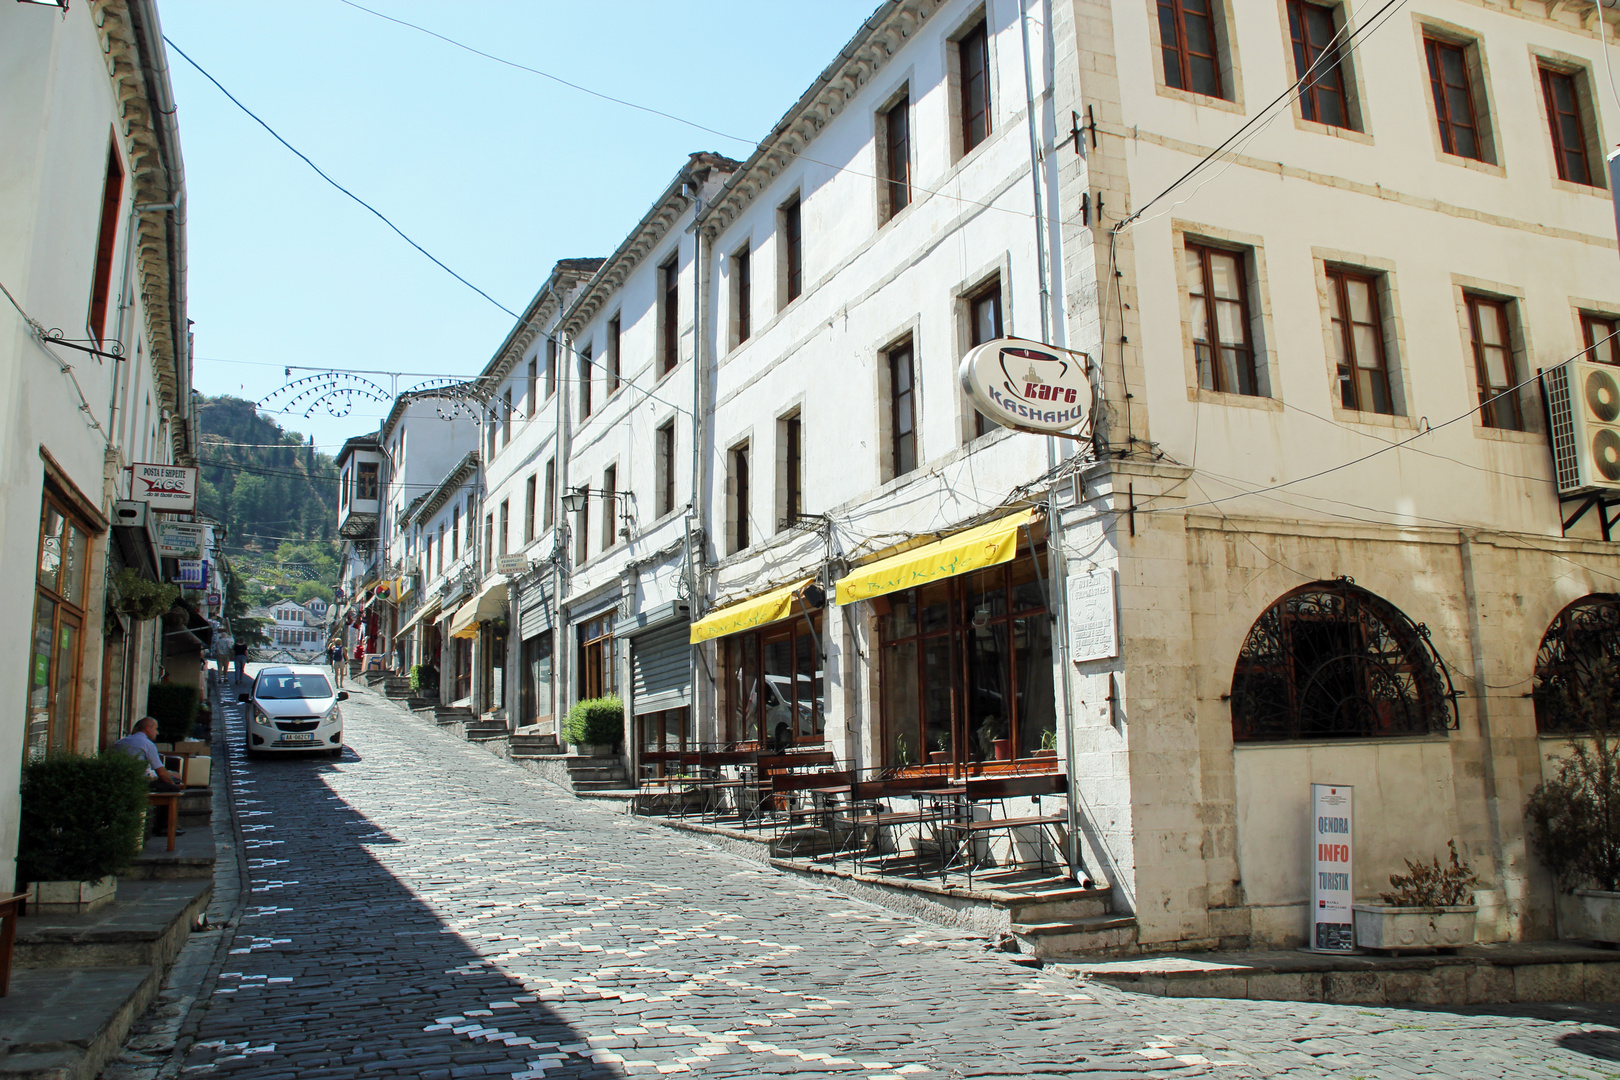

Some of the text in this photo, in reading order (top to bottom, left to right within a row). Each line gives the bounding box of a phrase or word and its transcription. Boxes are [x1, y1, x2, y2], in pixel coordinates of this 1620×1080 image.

[988, 385, 1082, 423] KASHAHU
[144, 468, 160, 476] POSTA
[161, 469, 164, 477] E
[152, 478, 186, 491] ACS
[867, 556, 972, 592] Bar Kafe
[708, 626, 730, 635] Bar
[1318, 816, 1348, 834] QENDRA
[1318, 844, 1348, 862] INFO
[1318, 872, 1349, 891] TURISTIK
